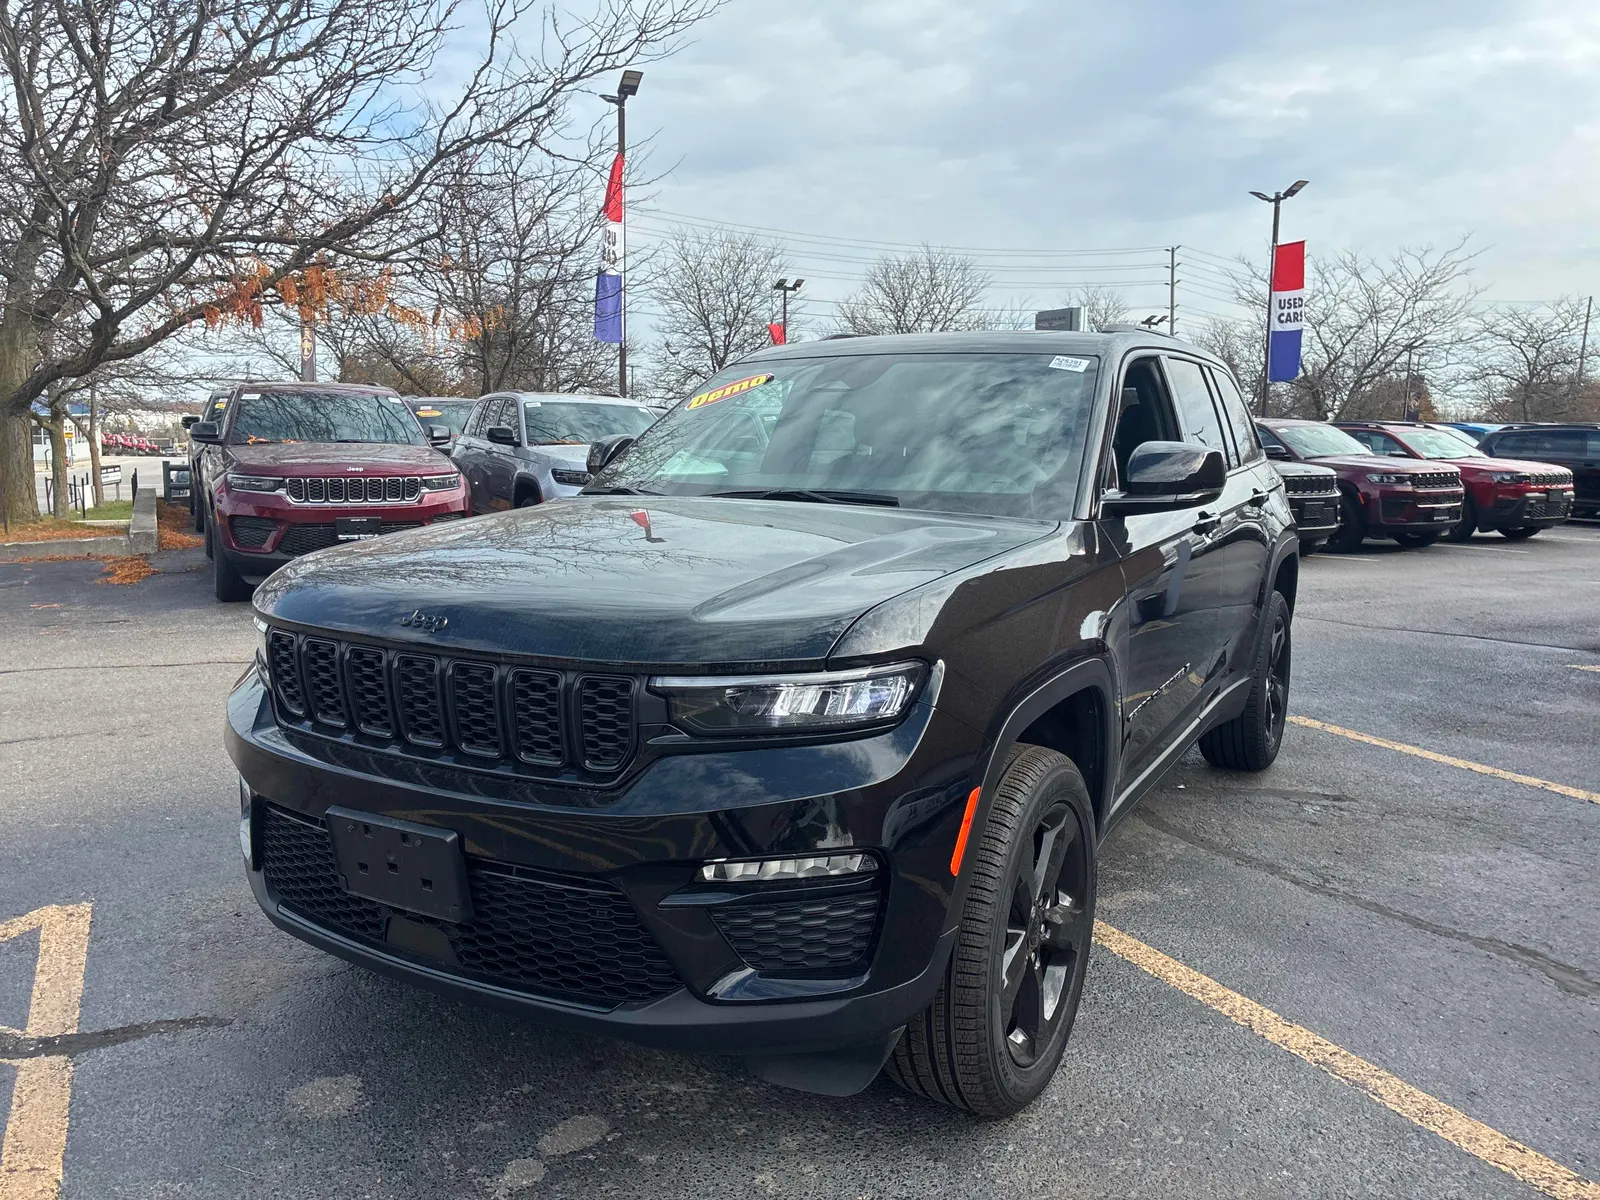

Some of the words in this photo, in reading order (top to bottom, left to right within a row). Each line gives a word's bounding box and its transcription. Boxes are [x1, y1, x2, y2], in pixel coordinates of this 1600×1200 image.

[1278, 297, 1304, 310] USED
[1277, 310, 1303, 324] CARS
[688, 375, 768, 410] Demo
[400, 609, 449, 634] Jeep
